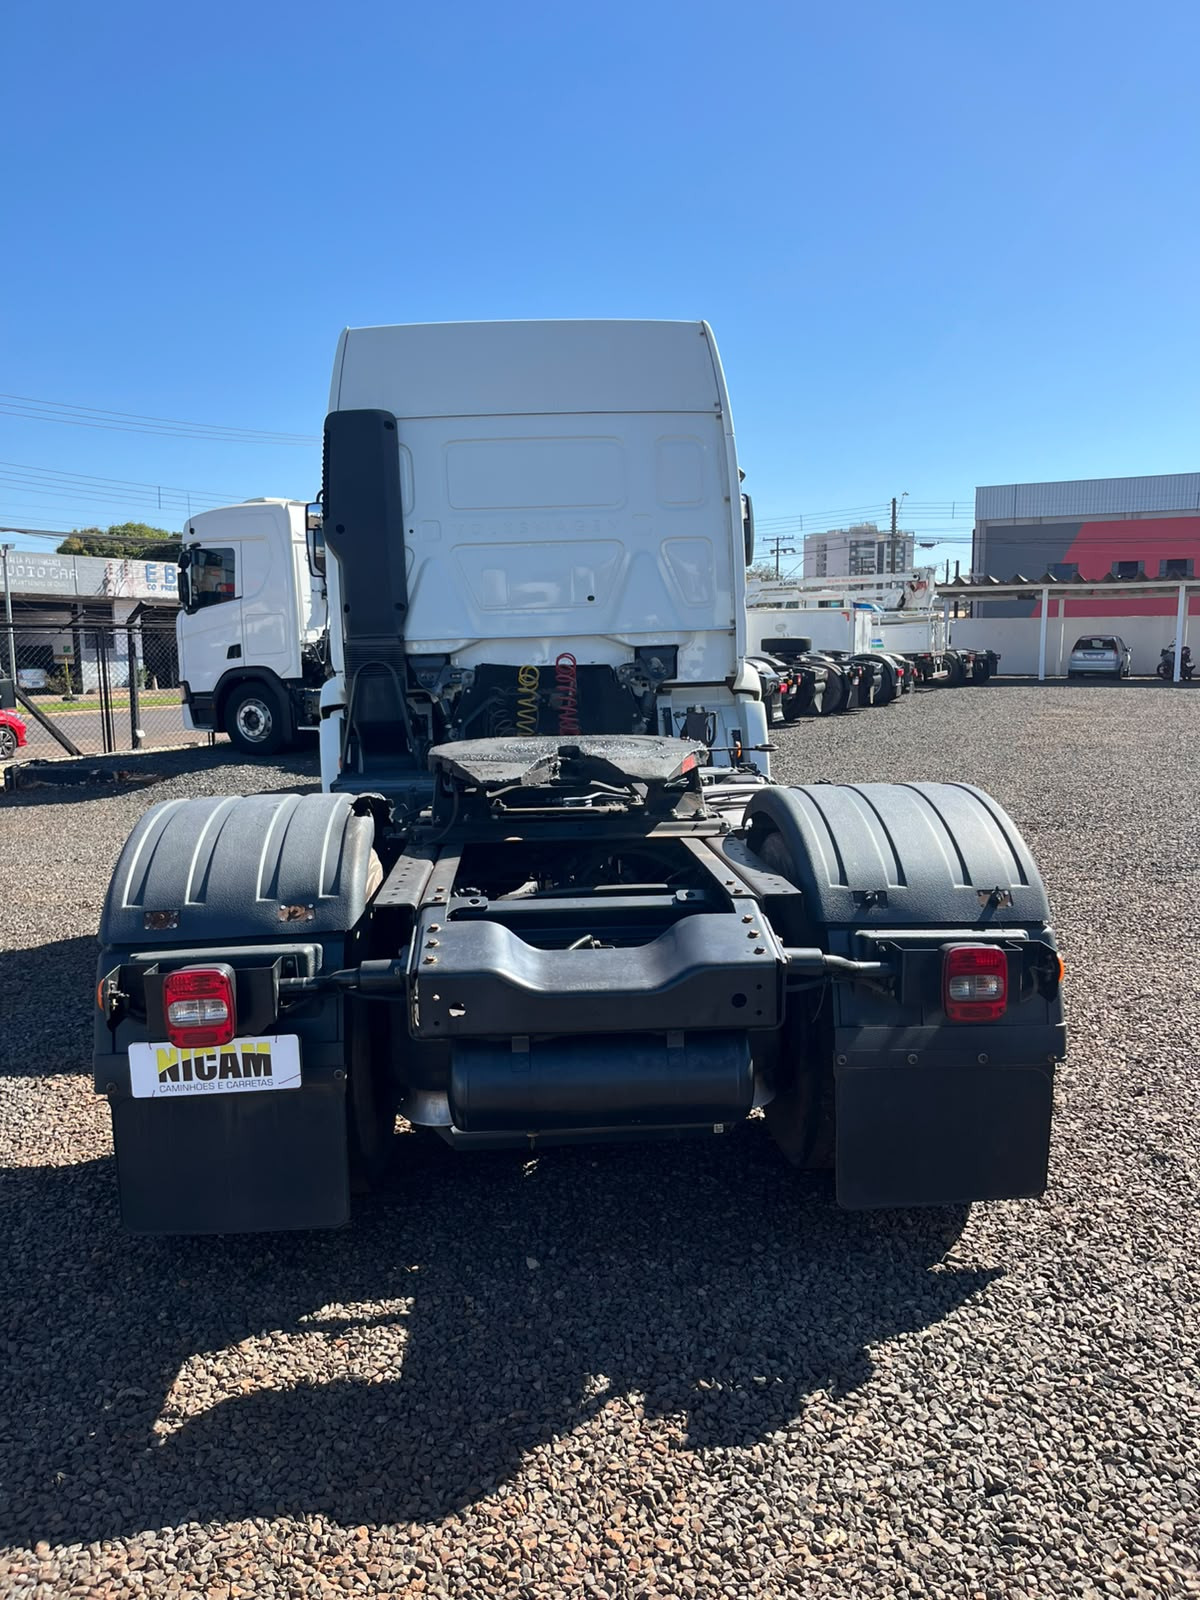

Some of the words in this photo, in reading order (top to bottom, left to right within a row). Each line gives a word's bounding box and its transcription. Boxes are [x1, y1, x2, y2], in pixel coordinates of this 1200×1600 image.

[156, 1042, 272, 1083] NICAM
[159, 1082, 215, 1093] CAMINHÕES
[226, 1078, 274, 1089] CARRETAS
